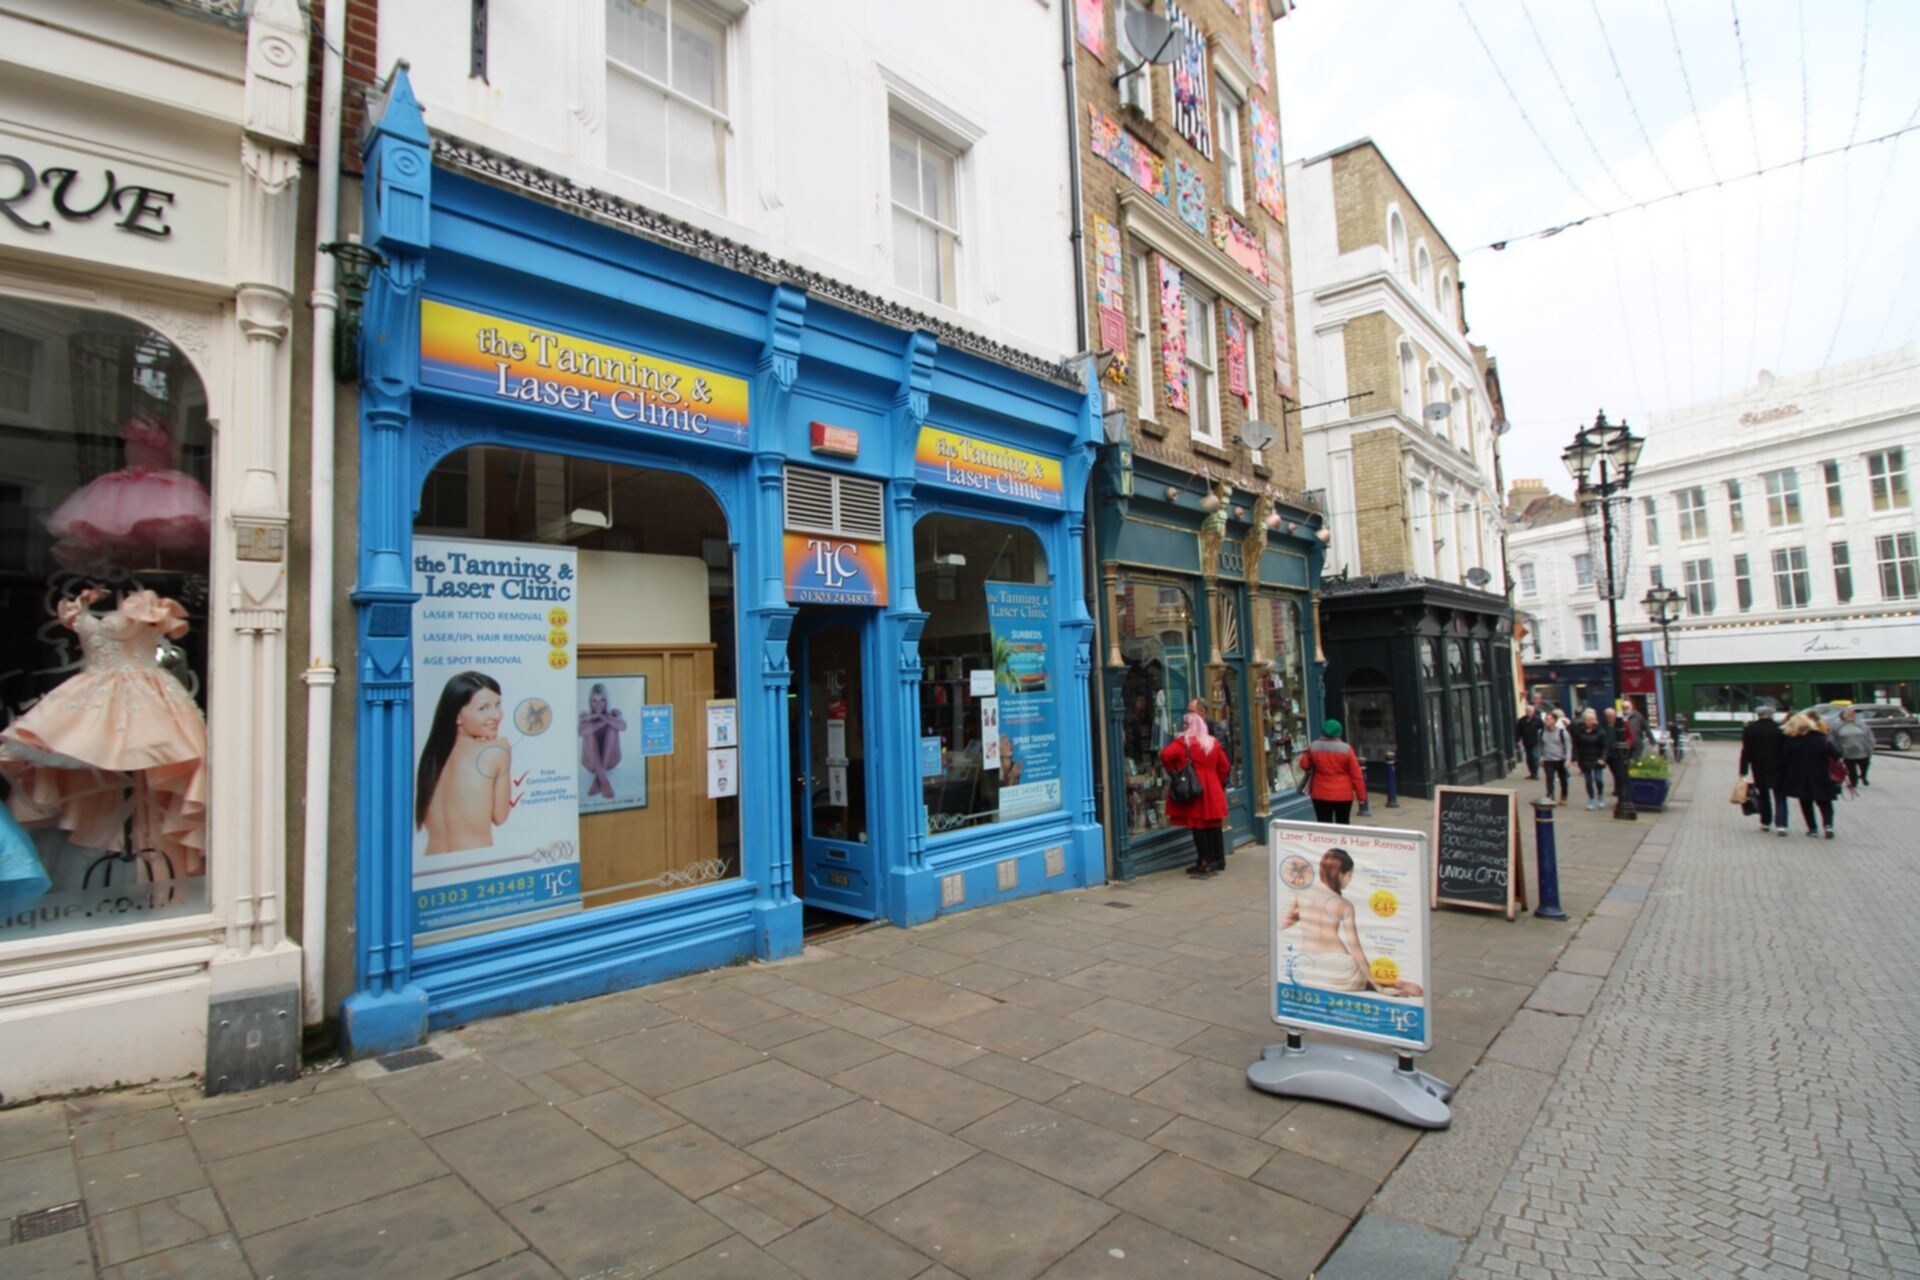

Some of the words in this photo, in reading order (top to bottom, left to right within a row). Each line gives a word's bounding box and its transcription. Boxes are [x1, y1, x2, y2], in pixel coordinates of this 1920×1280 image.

[476, 328, 526, 361] the
[529, 331, 682, 403] Tanning
[691, 378, 712, 403] &
[496, 362, 599, 414] Laser
[611, 389, 710, 434] Clinic
[936, 438, 958, 458] the
[959, 439, 1030, 480] Tanning
[1033, 461, 1045, 480] &
[945, 460, 992, 490] Laser
[996, 473, 1043, 500] Clinic
[415, 555, 446, 573] the
[448, 553, 552, 584] Tanning
[557, 563, 574, 580] &
[807, 539, 859, 588] TLC
[425, 575, 495, 599] Laser
[501, 579, 571, 601] Clinic
[999, 591, 1041, 608] Tanning
[423, 611, 454, 620] LASER
[458, 611, 496, 620] TATTOO
[498, 612, 543, 621] REMOVAL
[992, 604, 1019, 617] Laser
[1020, 605, 1047, 618] Clinic
[423, 633, 474, 643] LASER/IPL
[477, 633, 500, 642] HAIR
[503, 633, 547, 642] REMOVAL
[1011, 630, 1042, 640] SUNBEDS
[423, 656, 443, 666] AGE
[446, 656, 472, 665] SPOT
[475, 656, 522, 665] REMOVAL
[1280, 831, 1303, 841] Laser
[1306, 832, 1338, 844] Tattoo
[1340, 836, 1348, 845] &
[1350, 837, 1370, 847] Hair
[1374, 839, 1417, 851] Removal
[540, 869, 572, 897] TLC
[1440, 864, 1473, 880] UNIQUE
[1474, 866, 1509, 886] GIFTS
[418, 888, 468, 909] 01303
[477, 876, 536, 897] 243483
[1374, 968, 1397, 980] £35
[1282, 987, 1321, 1004] 01303
[1327, 997, 1380, 1016] 243483
[1386, 1007, 1418, 1032] TLC
